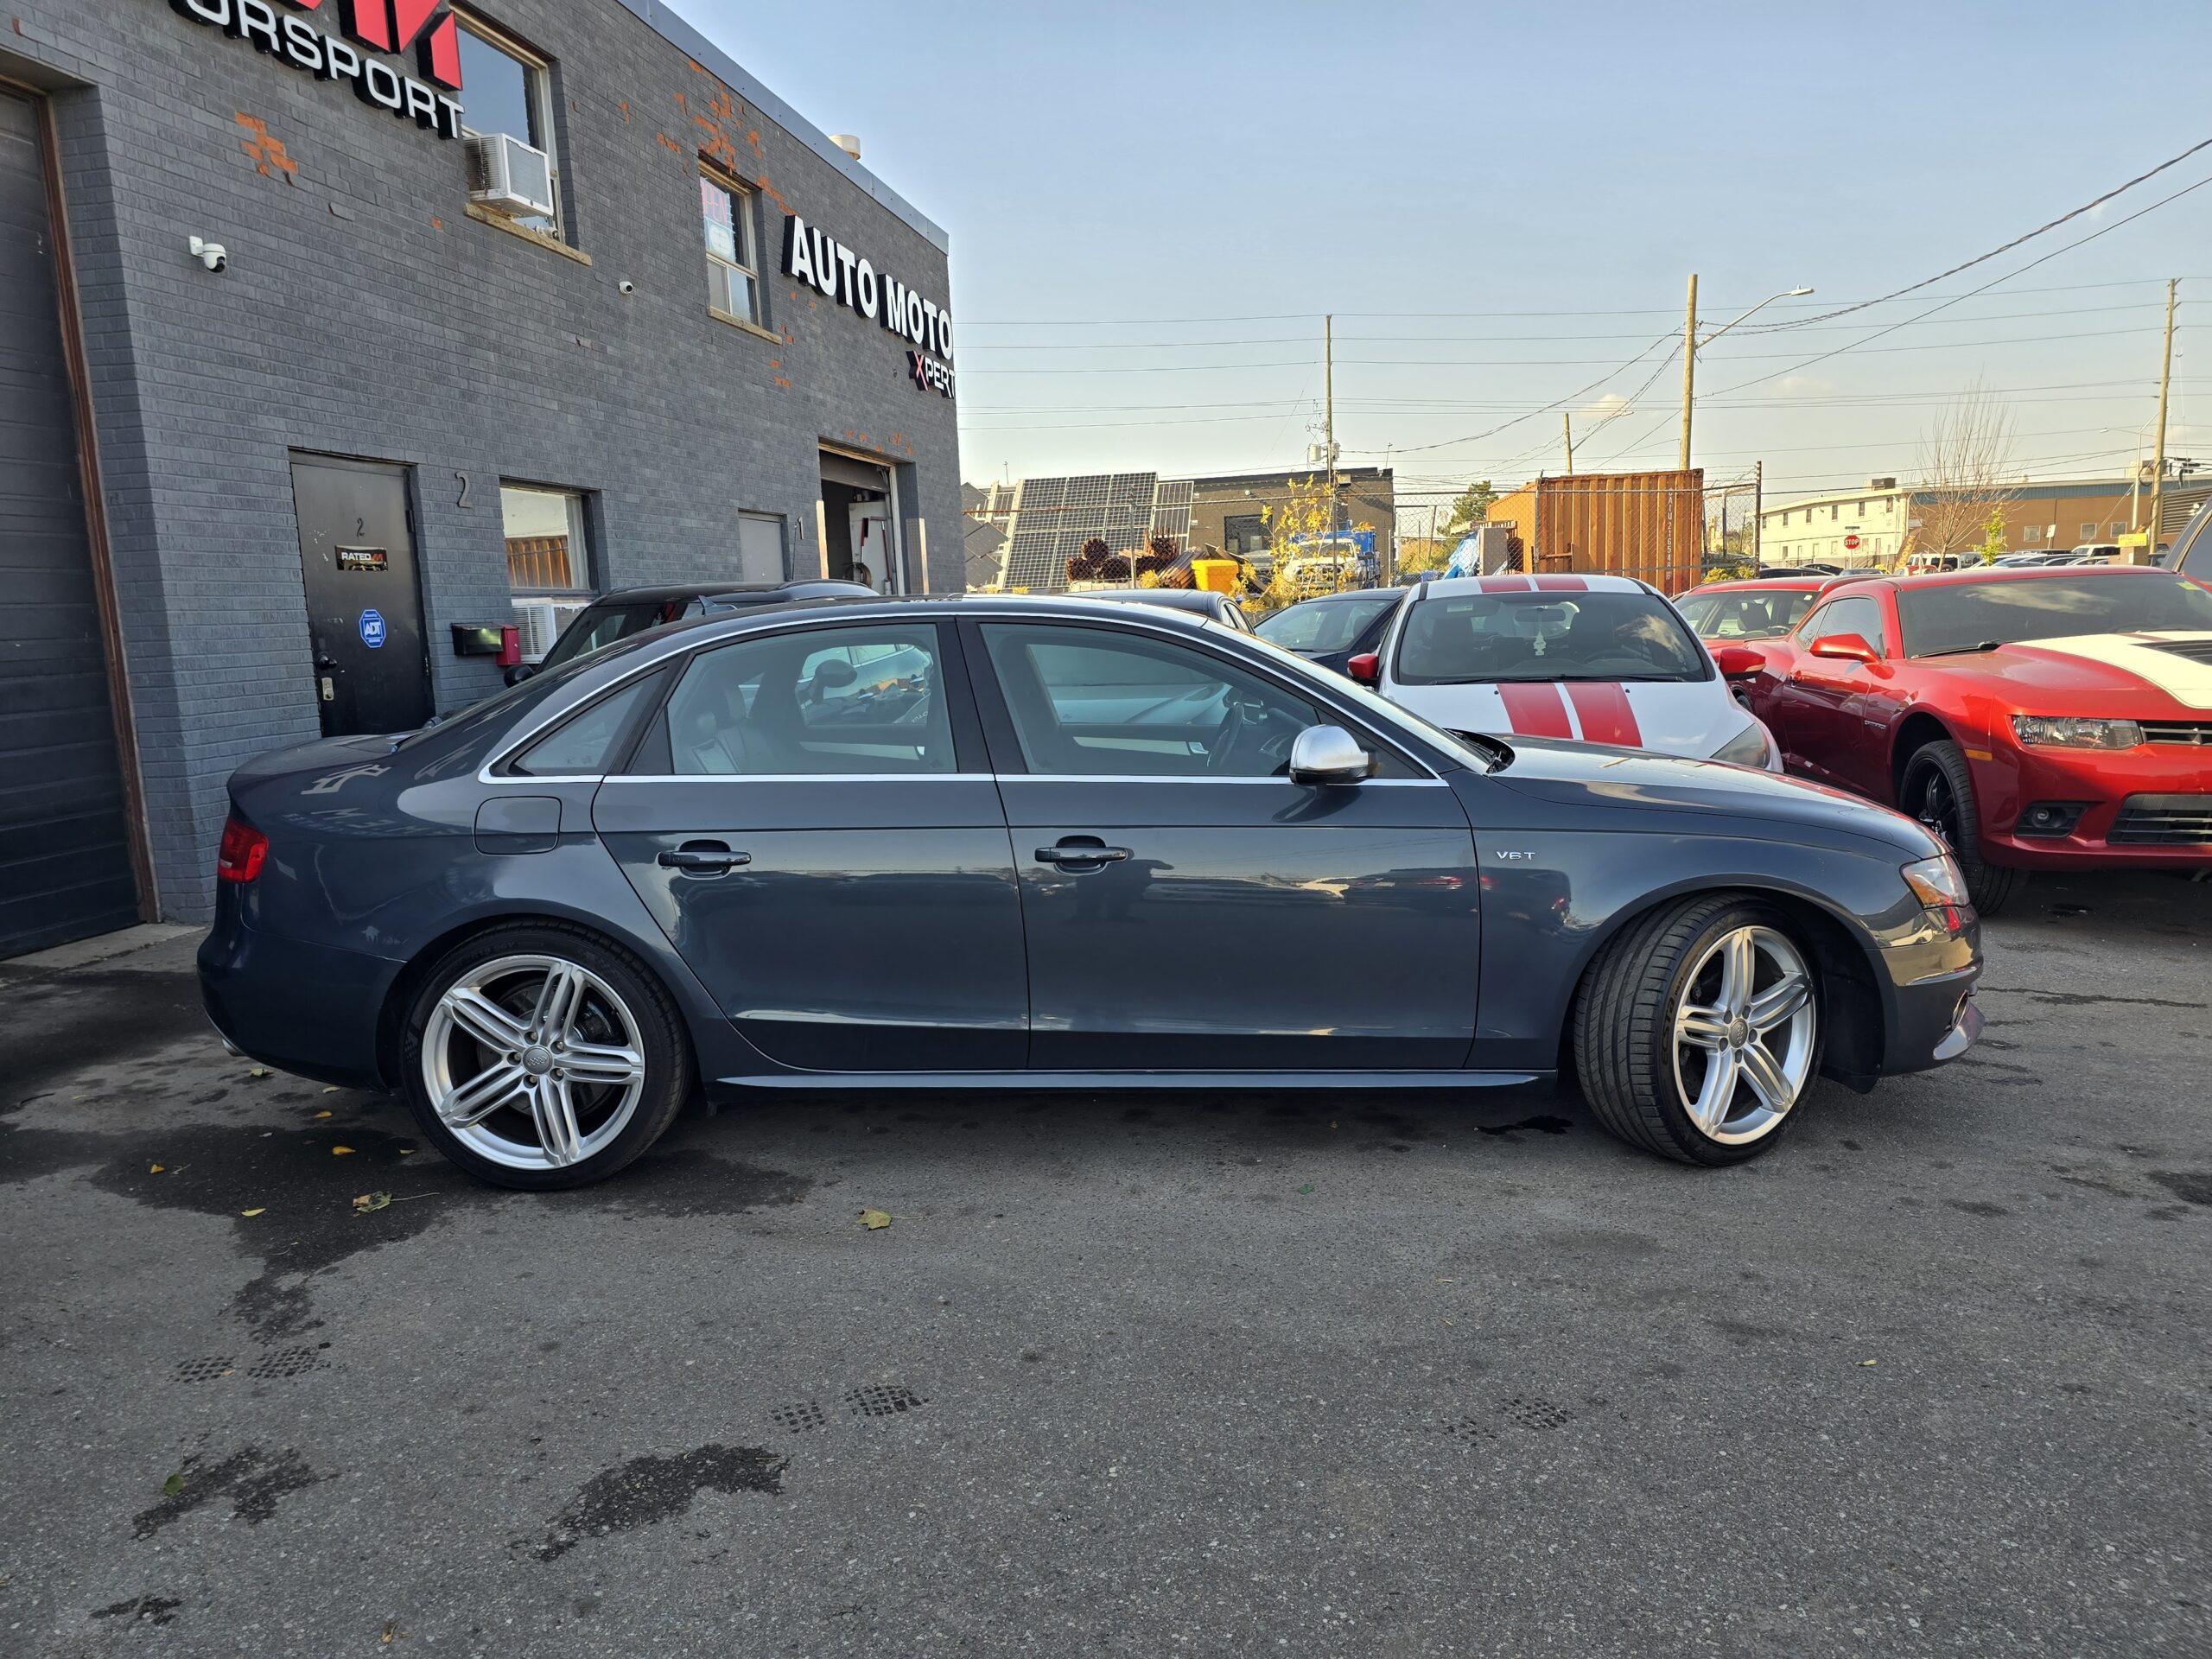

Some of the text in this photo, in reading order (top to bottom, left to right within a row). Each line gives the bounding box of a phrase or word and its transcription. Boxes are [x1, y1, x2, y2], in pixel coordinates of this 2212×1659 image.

[790, 215, 953, 360] AUTO MOTO
[455, 471, 473, 509] 2
[356, 518, 365, 537] 2
[340, 551, 372, 561] RATED
[365, 621, 381, 636] ADT
[1496, 851, 1535, 861] V6T
